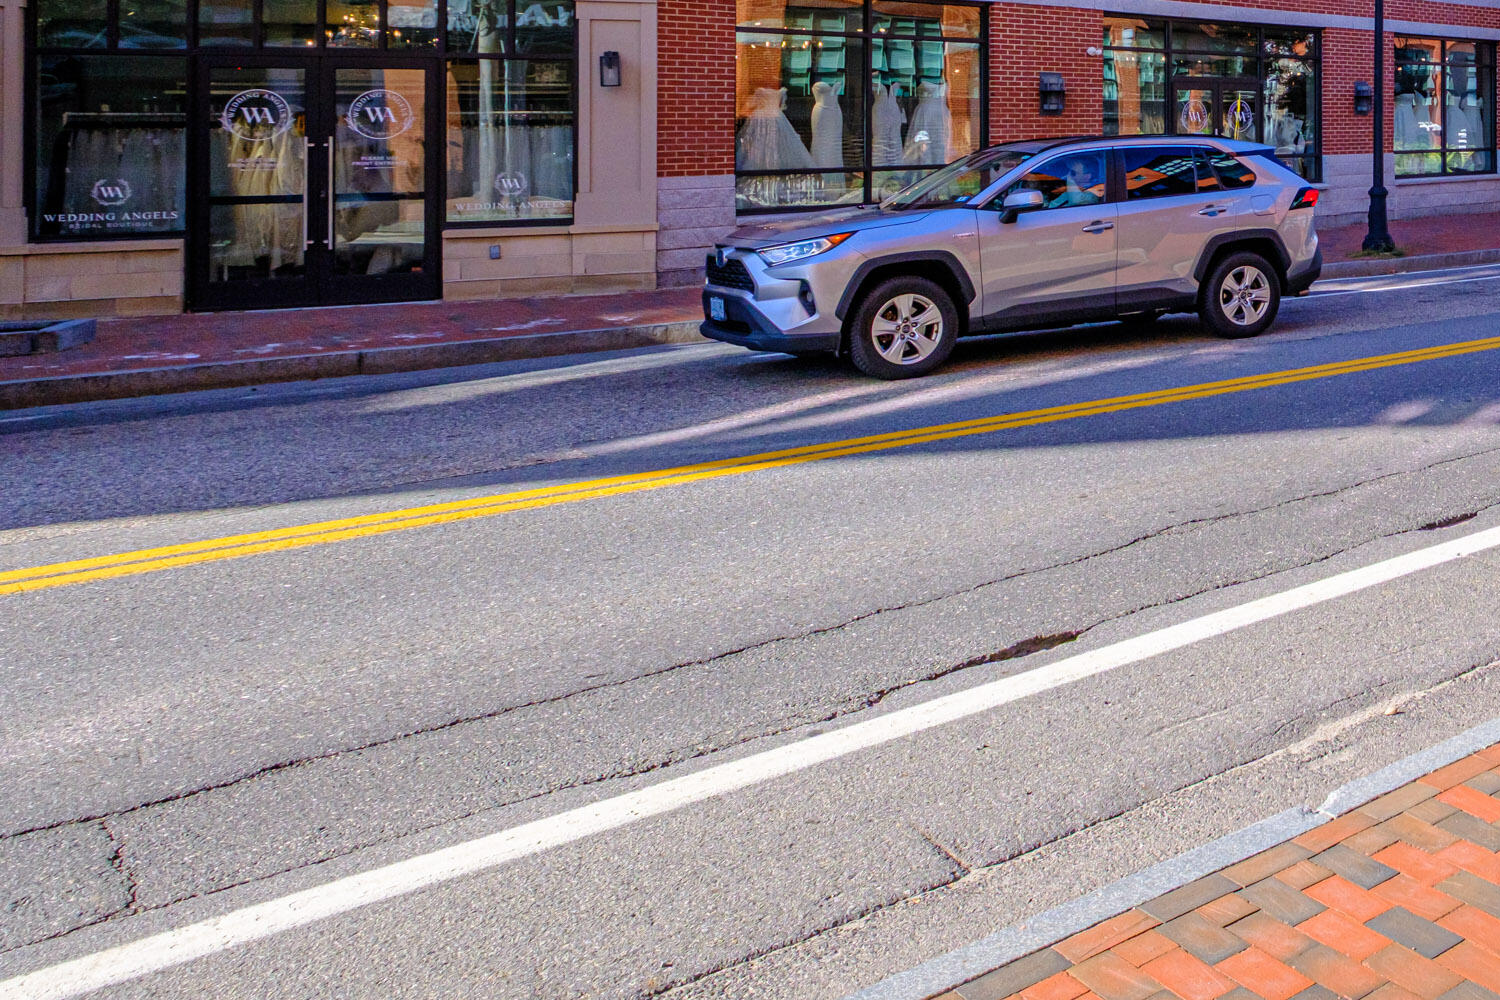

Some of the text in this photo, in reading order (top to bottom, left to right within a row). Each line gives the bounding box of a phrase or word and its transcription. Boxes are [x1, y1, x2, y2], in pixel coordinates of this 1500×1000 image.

[240, 107, 275, 124] WA
[365, 106, 397, 123] WA
[499, 179, 521, 189] WA
[99, 187, 124, 199] WA
[455, 200, 566, 211] WEDDING ANGELS
[43, 210, 179, 223] WEDDING ANGELS
